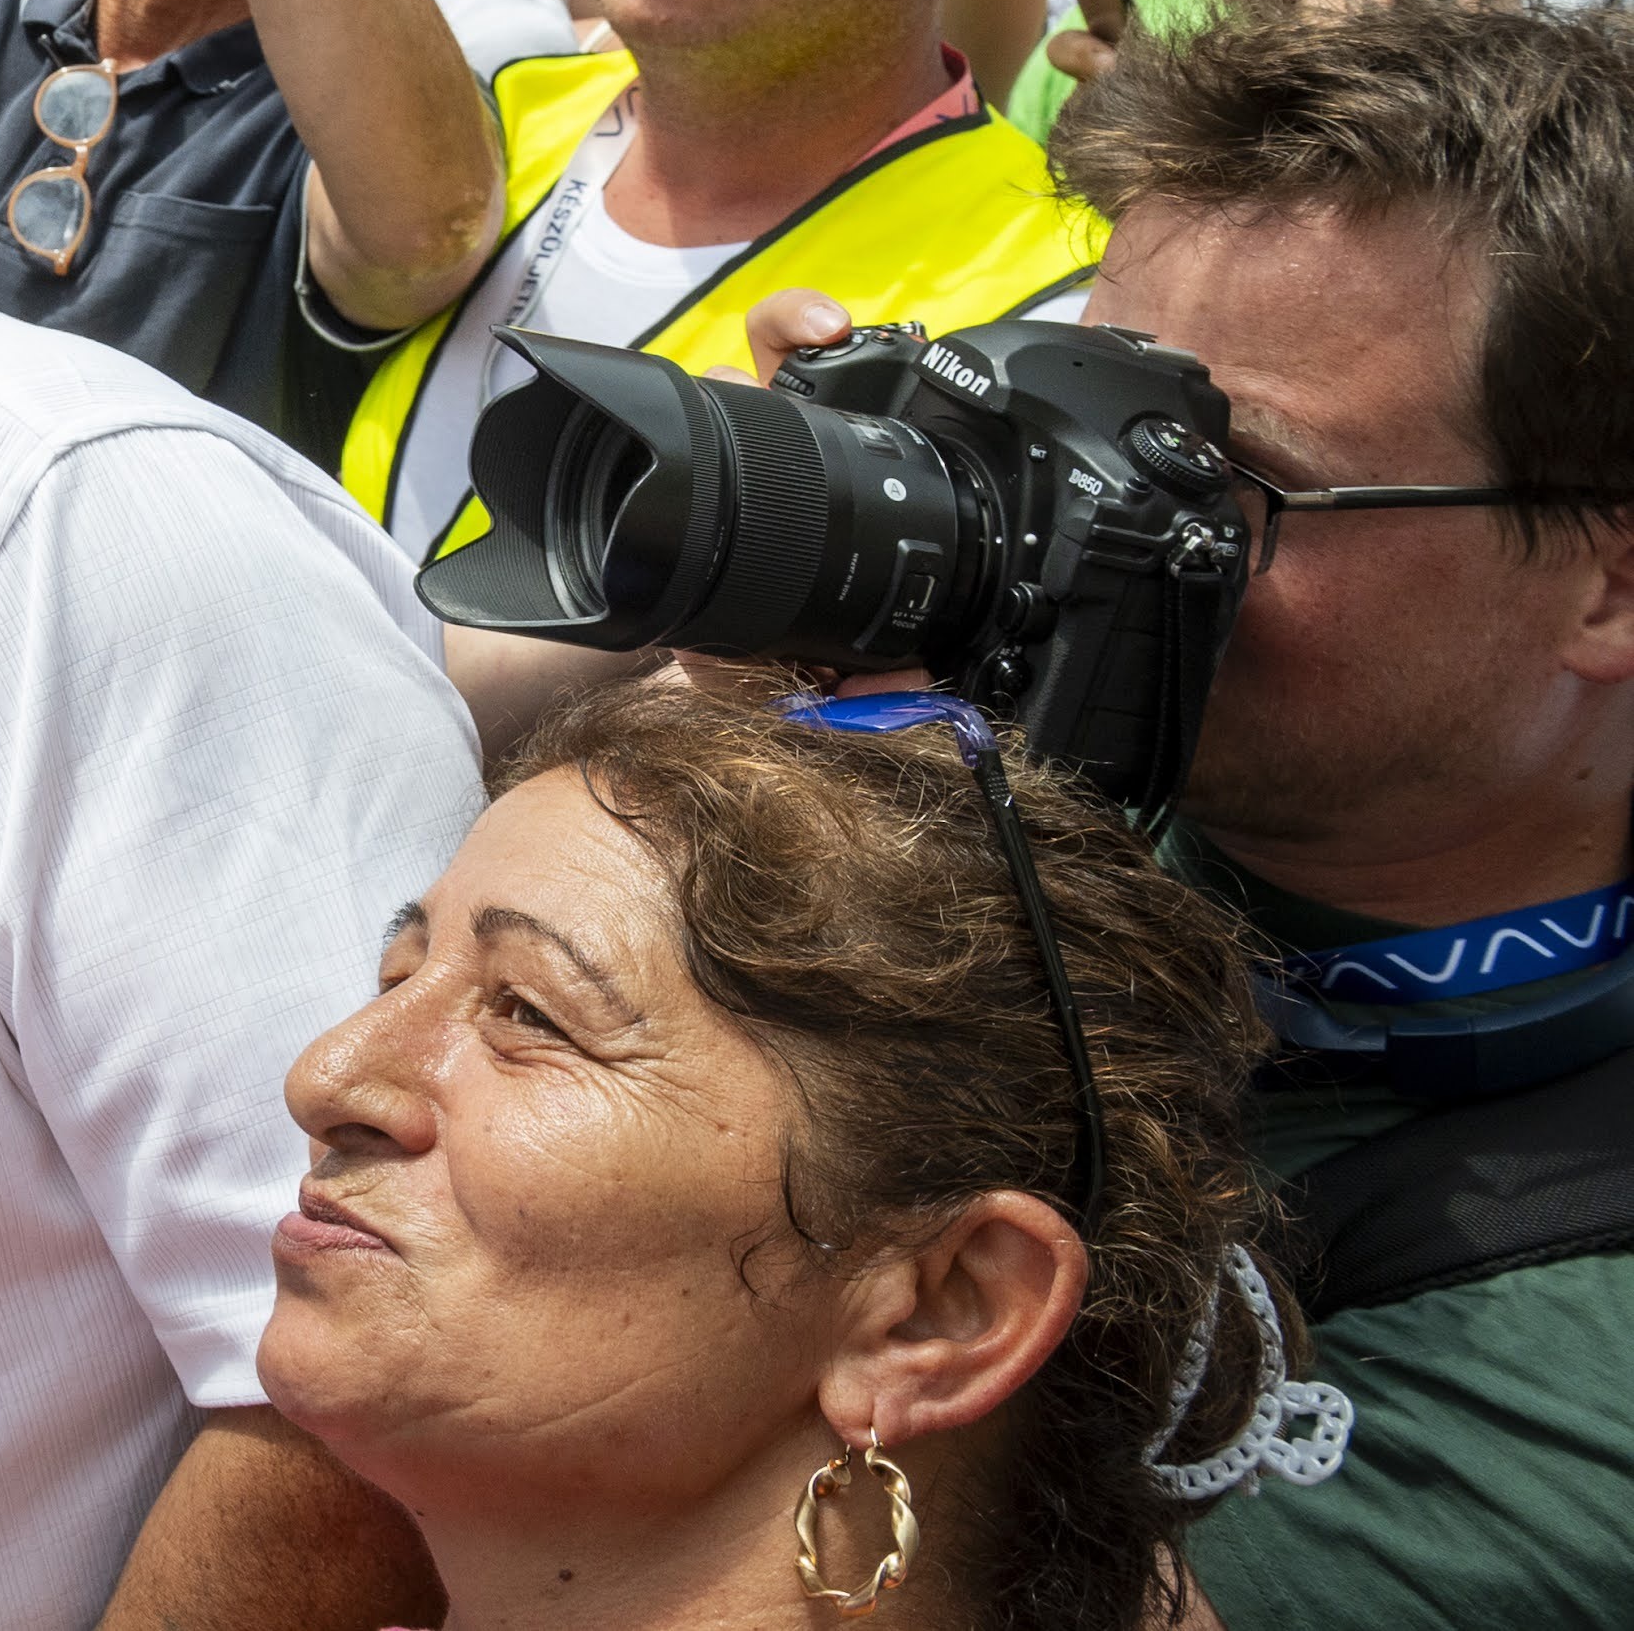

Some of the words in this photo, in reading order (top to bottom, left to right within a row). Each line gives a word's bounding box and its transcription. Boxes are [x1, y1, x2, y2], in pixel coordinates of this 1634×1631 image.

[921, 342, 991, 397] Nikon
[1068, 467, 1103, 496] D850
[892, 619, 916, 630] FOCUS
